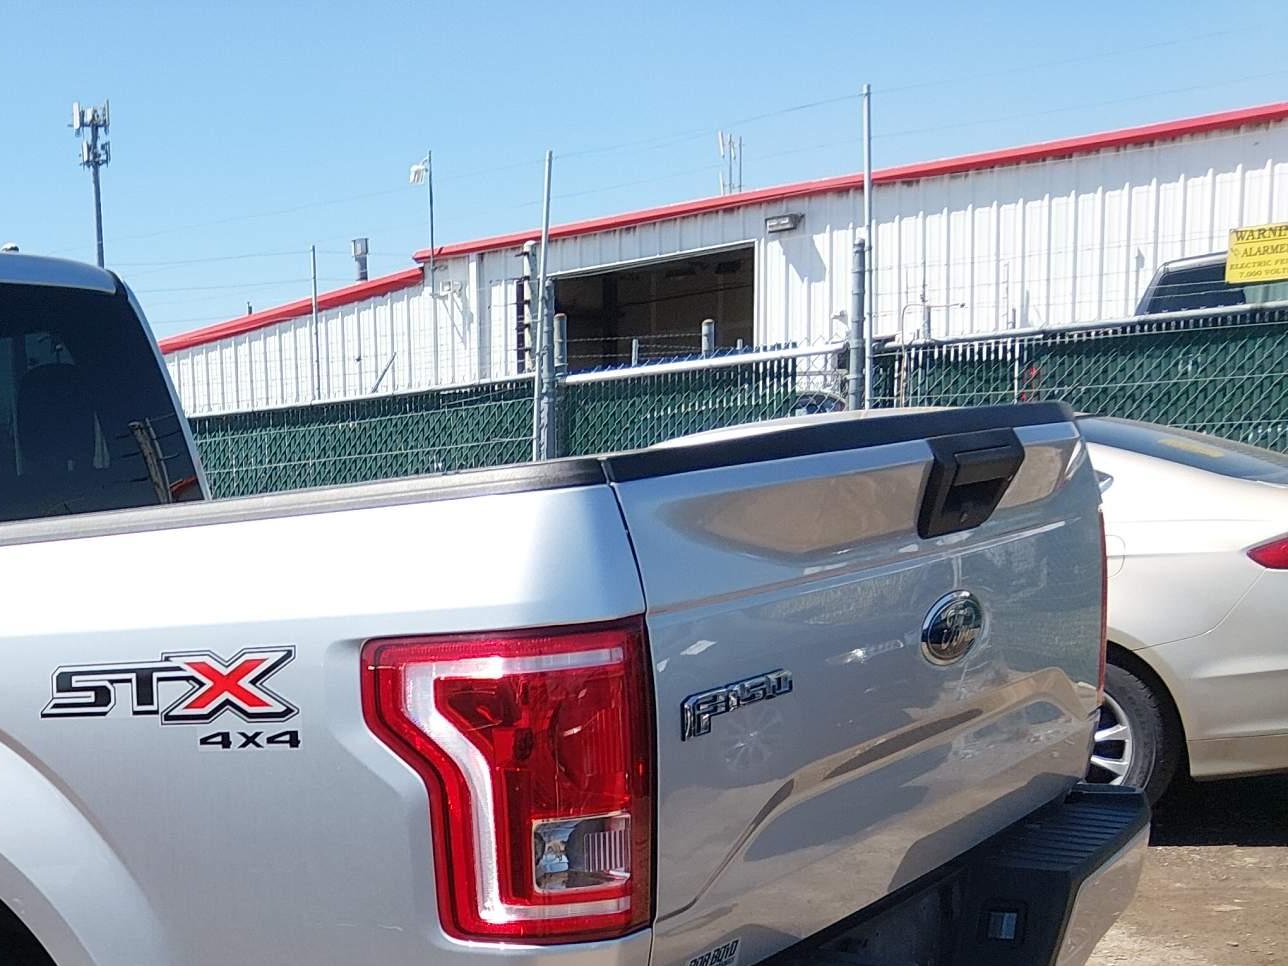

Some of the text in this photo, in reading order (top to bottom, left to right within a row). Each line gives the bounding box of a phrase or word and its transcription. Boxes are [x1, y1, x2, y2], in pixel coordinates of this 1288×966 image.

[1241, 243, 1288, 257] ALARME
[1274, 257, 1288, 266] FE
[41, 645, 300, 725] STX
